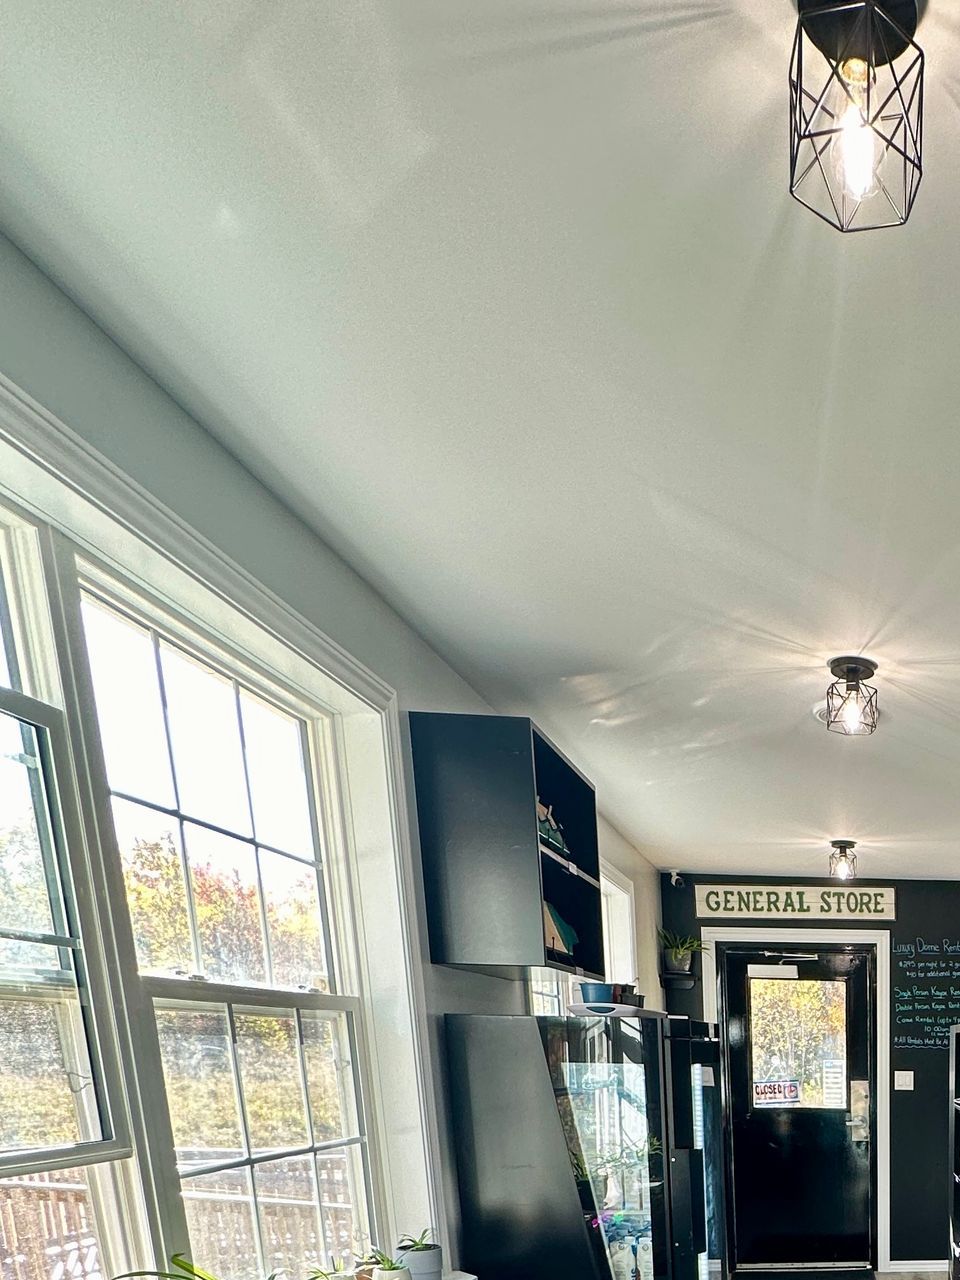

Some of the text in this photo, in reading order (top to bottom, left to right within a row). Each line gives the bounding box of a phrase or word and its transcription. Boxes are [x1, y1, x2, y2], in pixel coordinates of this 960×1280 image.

[705, 890, 885, 913] GENERAL STORE
[892, 937, 916, 958] Luxury
[916, 937, 940, 953] Dome
